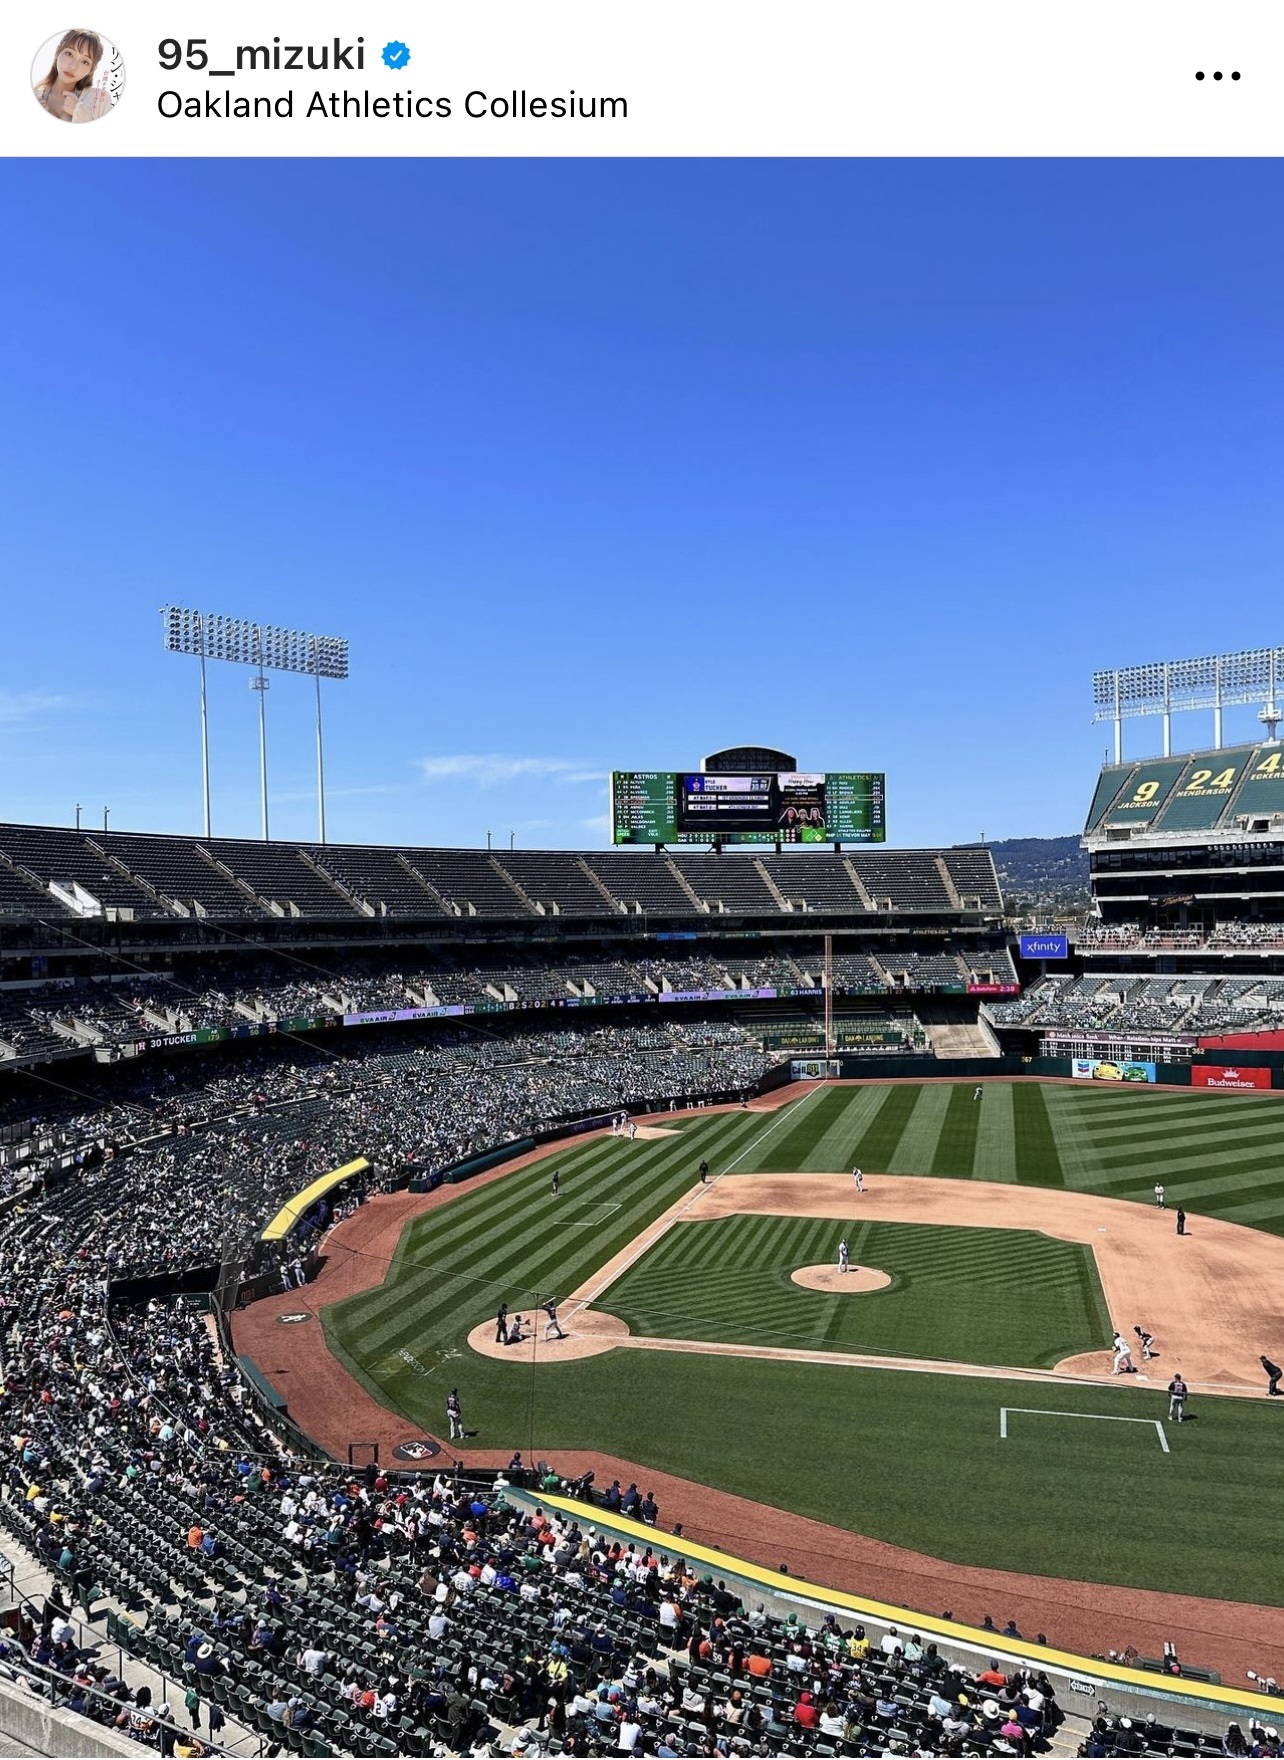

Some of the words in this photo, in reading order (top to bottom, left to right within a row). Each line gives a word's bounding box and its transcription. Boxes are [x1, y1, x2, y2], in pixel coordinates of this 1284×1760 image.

[1185, 768, 1236, 790] 24
[1133, 781, 1160, 802] 9
[1176, 787, 1233, 797] HENDERSON
[1117, 800, 1160, 809] JACKSON
[1027, 941, 1060, 953] xfinity
[150, 1038, 162, 1048] 30
[162, 1034, 197, 1047] TUCKER
[1191, 1047, 1205, 1055] 362
[1207, 1078, 1255, 1088] Budweiser
[853, 1644, 862, 1652] 34
[712, 1651, 723, 1664] 59
[375, 1702, 382, 1715] 2
